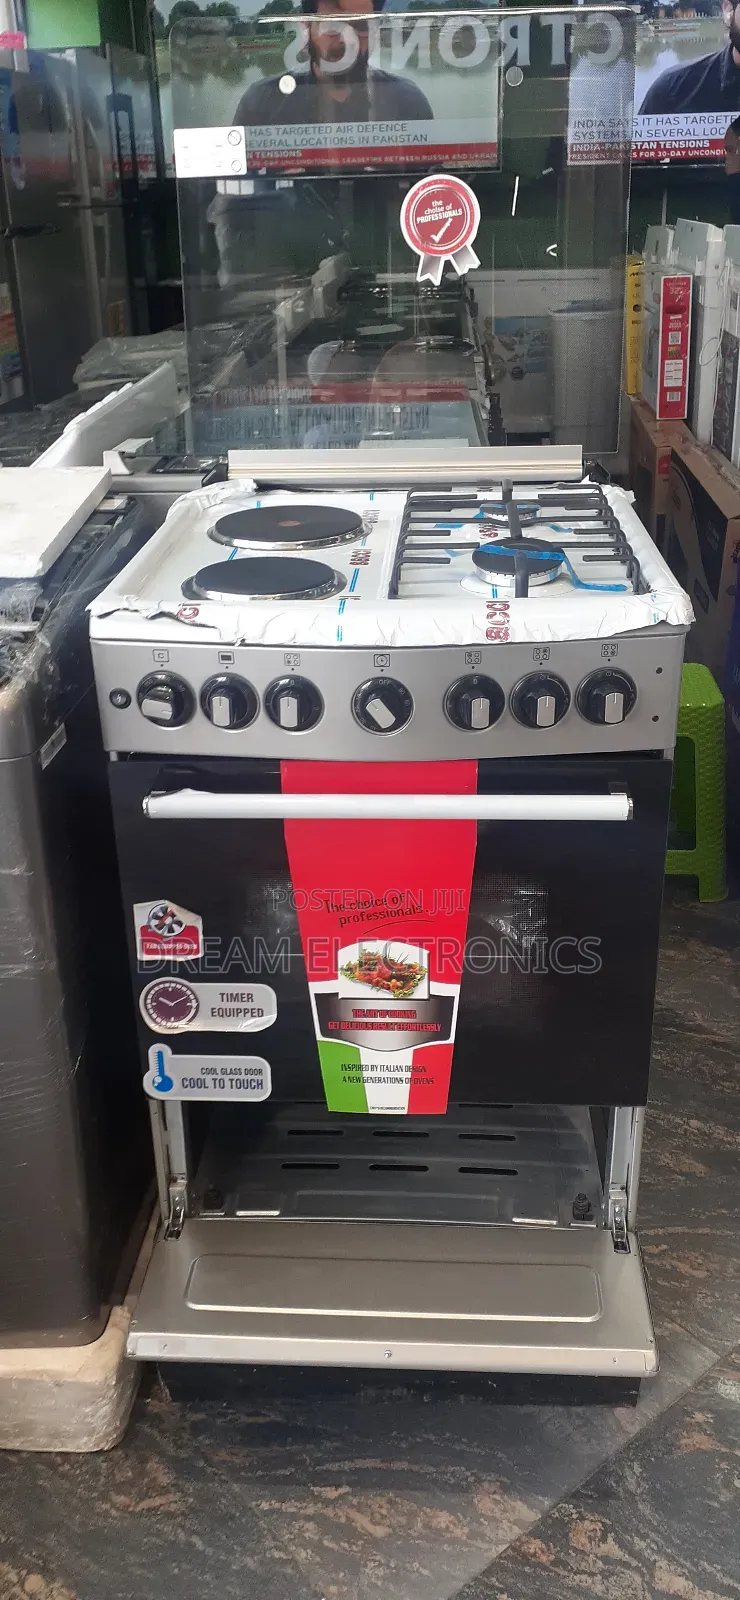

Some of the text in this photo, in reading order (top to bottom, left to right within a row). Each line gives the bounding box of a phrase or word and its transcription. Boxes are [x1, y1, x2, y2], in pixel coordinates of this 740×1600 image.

[574, 119, 605, 129] INDIA
[642, 117, 652, 126] IT
[656, 116, 680, 126] HAS
[250, 122, 407, 137] HAS TARGETED AIR DEFENCE
[646, 128, 699, 138] SEVERAL
[294, 135, 355, 147] LOCATIONS
[359, 135, 369, 144] IN
[373, 133, 428, 143] PAKISTAN
[659, 139, 710, 149] TENSIONS
[254, 149, 302, 158] TENSIONS
[384, 155, 421, 163] BETWEEN
[416, 209, 463, 224] PROFESSIONALS
[323, 892, 407, 914] The choice of
[219, 992, 254, 1003] TIMER
[210, 1007, 265, 1018] EQUIPPED
[352, 1008, 417, 1019] THE ART OF COOKING
[328, 1021, 340, 1030] GET
[341, 1021, 372, 1031] DELICIOUS
[397, 1023, 441, 1032] EFFORTLESSLY
[200, 1067, 263, 1076] COOL GLASS DOOR
[341, 1063, 427, 1073] INSPIRED BY ITALIAN DESIGN
[181, 1077, 264, 1090] COOL TO TOUCH
[342, 1076, 435, 1085] A NEW GENERATIONS OF OVENS
